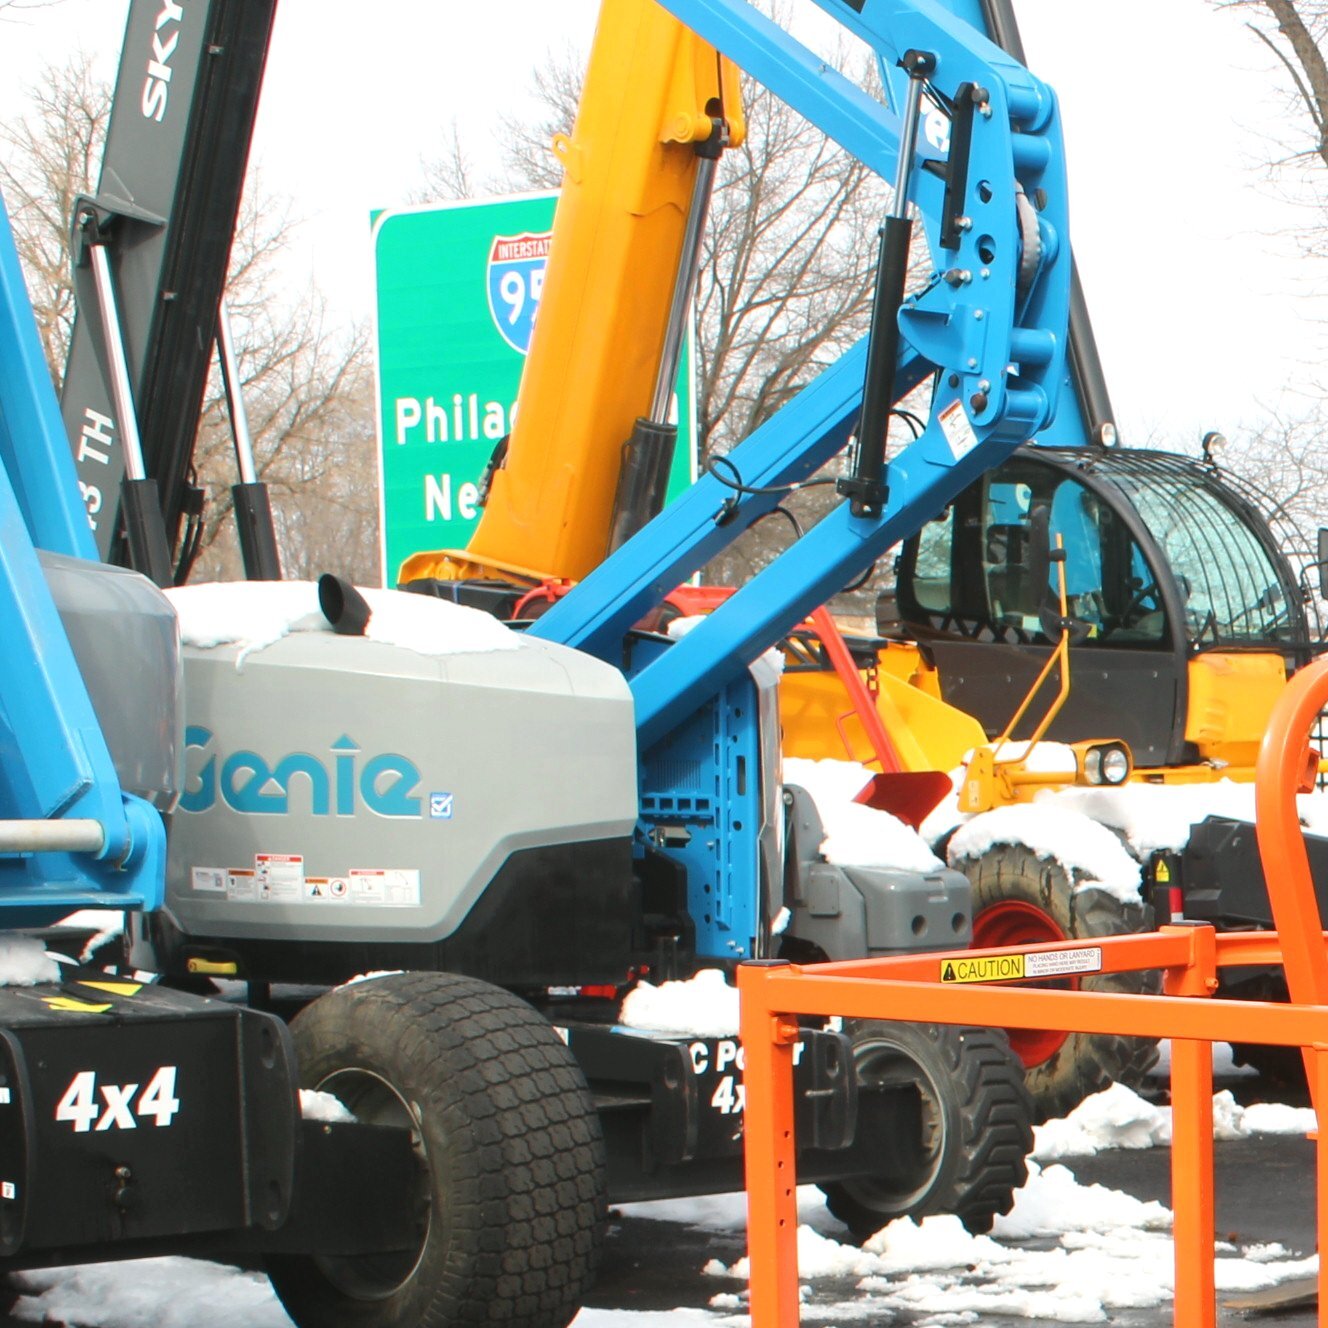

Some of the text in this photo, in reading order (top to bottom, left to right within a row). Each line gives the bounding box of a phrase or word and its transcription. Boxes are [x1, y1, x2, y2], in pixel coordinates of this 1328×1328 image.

[78, 407, 114, 465] TH
[424, 473, 480, 522] Ne
[180, 725, 422, 816] Genie
[957, 958, 1020, 979] CAUTION
[1028, 955, 1038, 963] NO
[1039, 953, 1058, 962] HANDS
[1059, 952, 1068, 960] OR
[1069, 949, 1095, 959] LANYARD
[56, 1066, 180, 1132] 4x4
[711, 1076, 746, 1114] 4x
